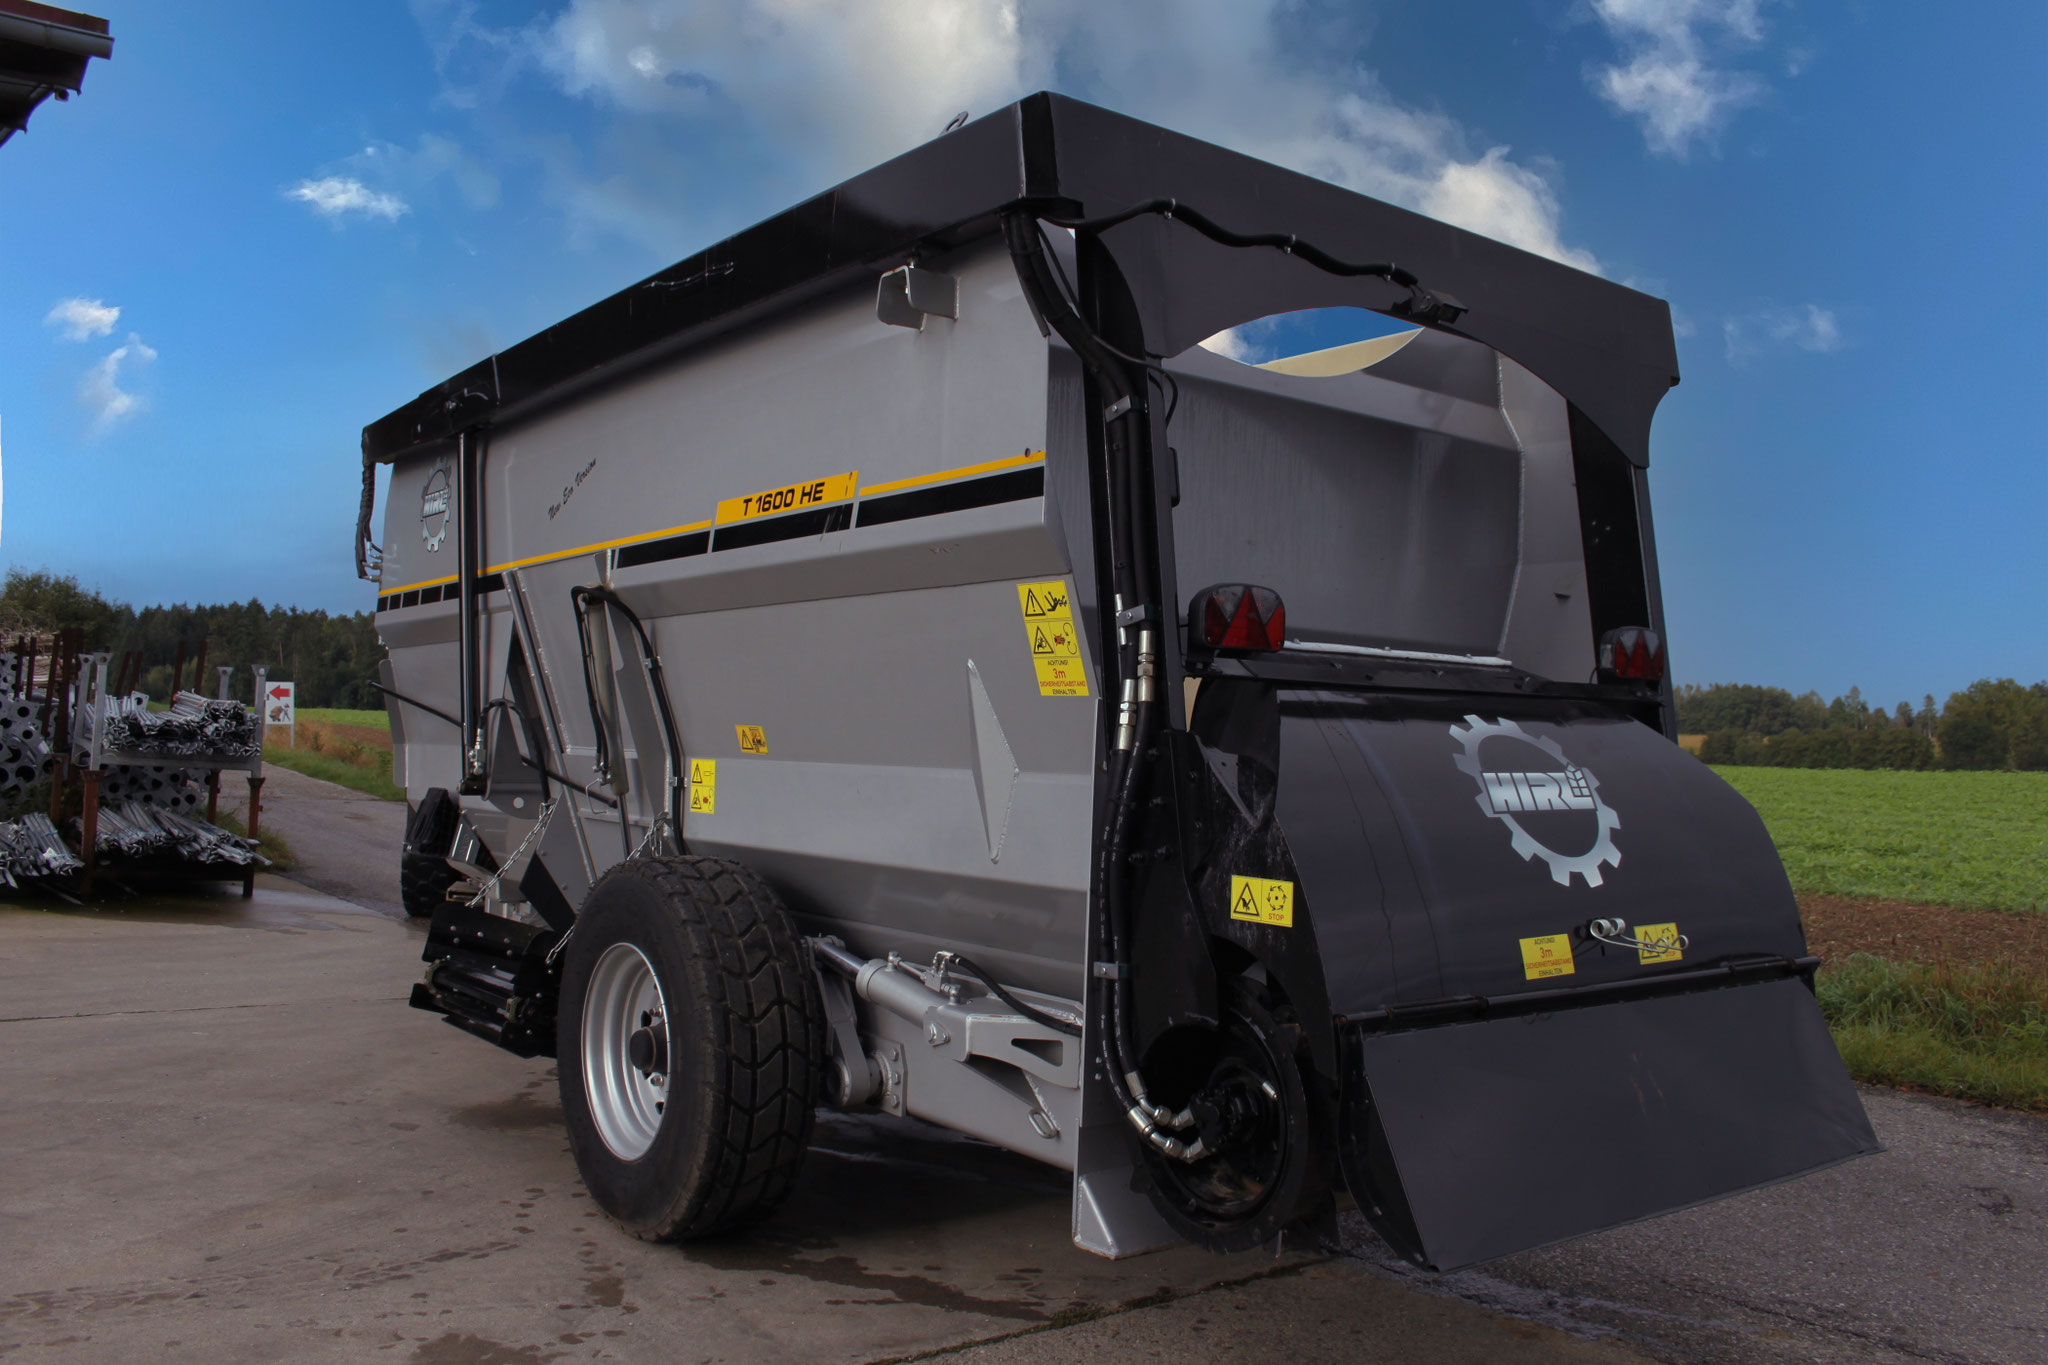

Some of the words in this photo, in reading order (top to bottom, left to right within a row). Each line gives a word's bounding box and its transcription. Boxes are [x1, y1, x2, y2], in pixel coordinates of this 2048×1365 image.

[743, 498, 753, 516] T
[755, 488, 795, 513] 1600
[799, 482, 825, 504] HE
[1053, 668, 1067, 679] 3m
[1482, 765, 1597, 812] HIRL
[1268, 913, 1285, 921] STOP
[1539, 947, 1554, 959] 3m
